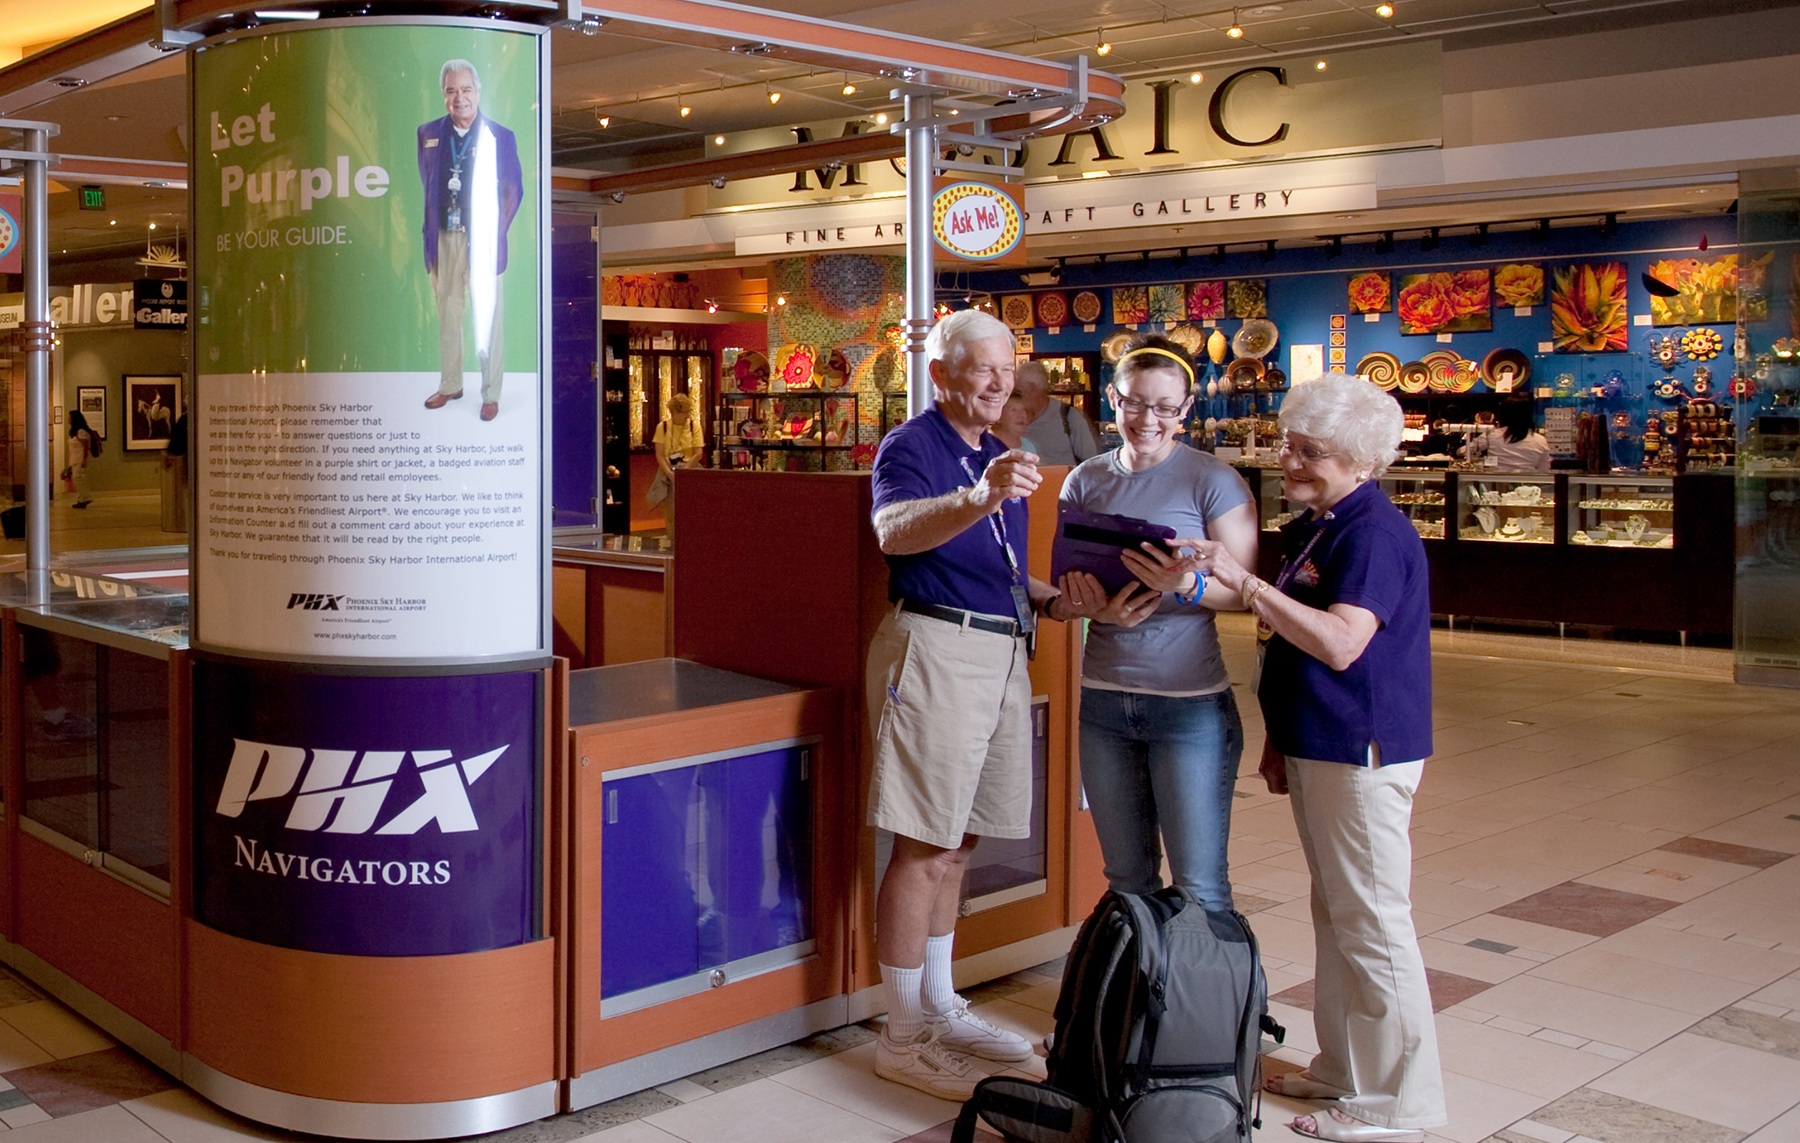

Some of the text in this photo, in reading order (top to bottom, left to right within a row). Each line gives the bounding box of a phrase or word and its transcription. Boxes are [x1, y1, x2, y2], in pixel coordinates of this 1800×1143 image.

[211, 102, 275, 151] Let
[789, 66, 1290, 192] MAIC
[221, 156, 390, 210] Purple
[85, 190, 102, 207] EXIT
[786, 190, 1292, 243] FINE AR AFT GALLERY
[952, 205, 999, 235] Ask Me!
[217, 226, 352, 252] BE YOUR GUIDE.
[50, 284, 133, 325] aller
[136, 307, 187, 324] Galler
[209, 404, 216, 412] As
[249, 404, 280, 414] through
[282, 403, 316, 412] Phoenix
[319, 404, 337, 413] Sky
[340, 403, 373, 412] Harbor
[209, 417, 382, 427] Interntional Airport, please remember that
[229, 430, 244, 439] here
[245, 431, 255, 439] for
[327, 432, 373, 441] questions
[389, 432, 408, 441] just
[209, 444, 223, 452] point
[223, 445, 235, 453] you
[258, 445, 277, 454] right
[278, 445, 319, 453] direction.
[322, 445, 330, 453] If
[352, 445, 376, 453] need
[378, 445, 420, 455] anything
[435, 445, 453, 454] Sky
[455, 445, 487, 454] Harbor,
[489, 445, 505, 454] just
[506, 444, 524, 452] walk
[229, 457, 262, 467] Navigator
[264, 458, 303, 467] volunteer
[324, 459, 354, 468] purple
[357, 459, 378, 467] shirt
[394, 459, 426, 468] jacket,
[438, 459, 471, 468] badged
[473, 459, 506, 467] aviation
[508, 457, 525, 466] staff
[241, 472, 255, 480] any
[256, 471, 265, 479] of
[282, 472, 314, 482] friendly
[317, 472, 337, 481] food
[340, 473, 358, 481] and
[361, 473, 385, 481] retail
[388, 473, 442, 482] employees.
[209, 489, 236, 498] Customer
[237, 492, 262, 500] service
[264, 492, 271, 500] is
[273, 494, 291, 502] very
[293, 493, 337, 502] important
[340, 494, 350, 502] to
[367, 494, 388, 502] here
[391, 494, 401, 502] at
[404, 494, 422, 503] Sky
[425, 493, 458, 502] Harbor.
[461, 493, 475, 501] We
[504, 492, 524, 500] think
[209, 502, 215, 510] of
[216, 504, 244, 512] ourselves
[298, 506, 345, 516] Friendliest
[394, 508, 408, 516] We
[412, 508, 460, 516] encourage
[464, 508, 479, 516] you
[494, 506, 510, 514] visit
[209, 515, 244, 526] Information
[245, 518, 277, 527] Counter
[298, 520, 309, 528] fill
[311, 521, 328, 529] out
[339, 522, 386, 530] comment
[388, 522, 411, 530] card
[413, 521, 442, 529] about
[444, 522, 466, 530] your
[468, 520, 514, 529] experience
[516, 519, 524, 527] at
[209, 528, 483, 545] Sky Harbor. We guarantee that it will be read by the right people.
[1304, 527, 1326, 554] NAVIGAT
[209, 548, 226, 557] Thank
[240, 551, 251, 559] for
[252, 552, 287, 563] traveling
[289, 554, 325, 564] through
[327, 555, 365, 564] Phoenix
[368, 556, 386, 565] Sky
[390, 556, 424, 564] Harbor
[426, 554, 484, 564] International
[487, 553, 517, 562] Airport!
[286, 593, 346, 610] PHX
[346, 597, 378, 605] PHOENIX
[395, 597, 427, 605] HARBOR
[314, 631, 397, 641] www.phxskyharbor.com
[216, 738, 510, 835] PHX
[234, 834, 451, 885] NAVIGATORS
